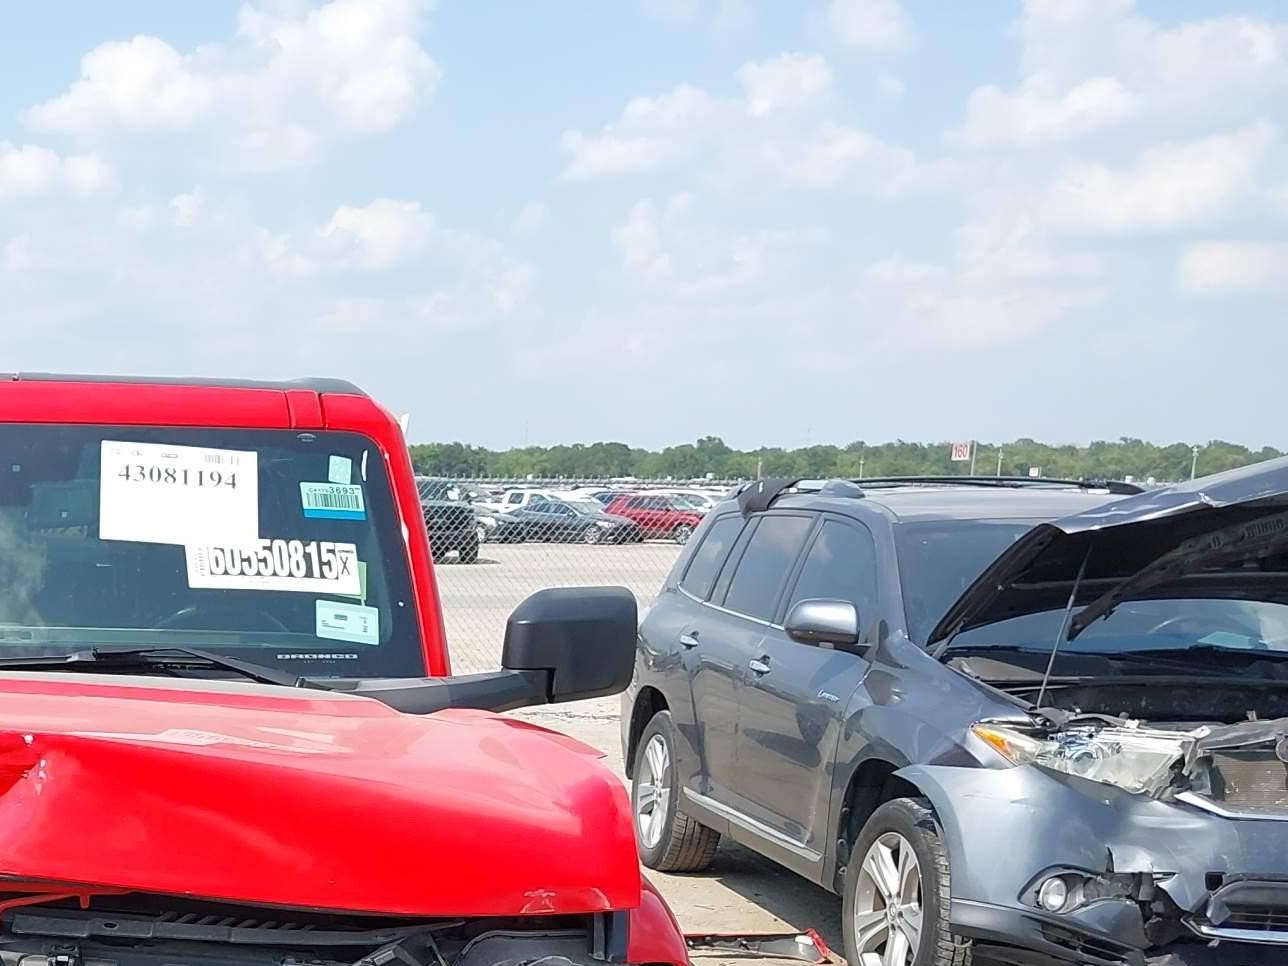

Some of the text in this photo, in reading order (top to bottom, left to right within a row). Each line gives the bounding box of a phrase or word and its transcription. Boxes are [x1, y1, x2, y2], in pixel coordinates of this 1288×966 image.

[954, 443, 969, 459] 160
[117, 464, 238, 489] 43081194
[209, 539, 338, 580] 60550815
